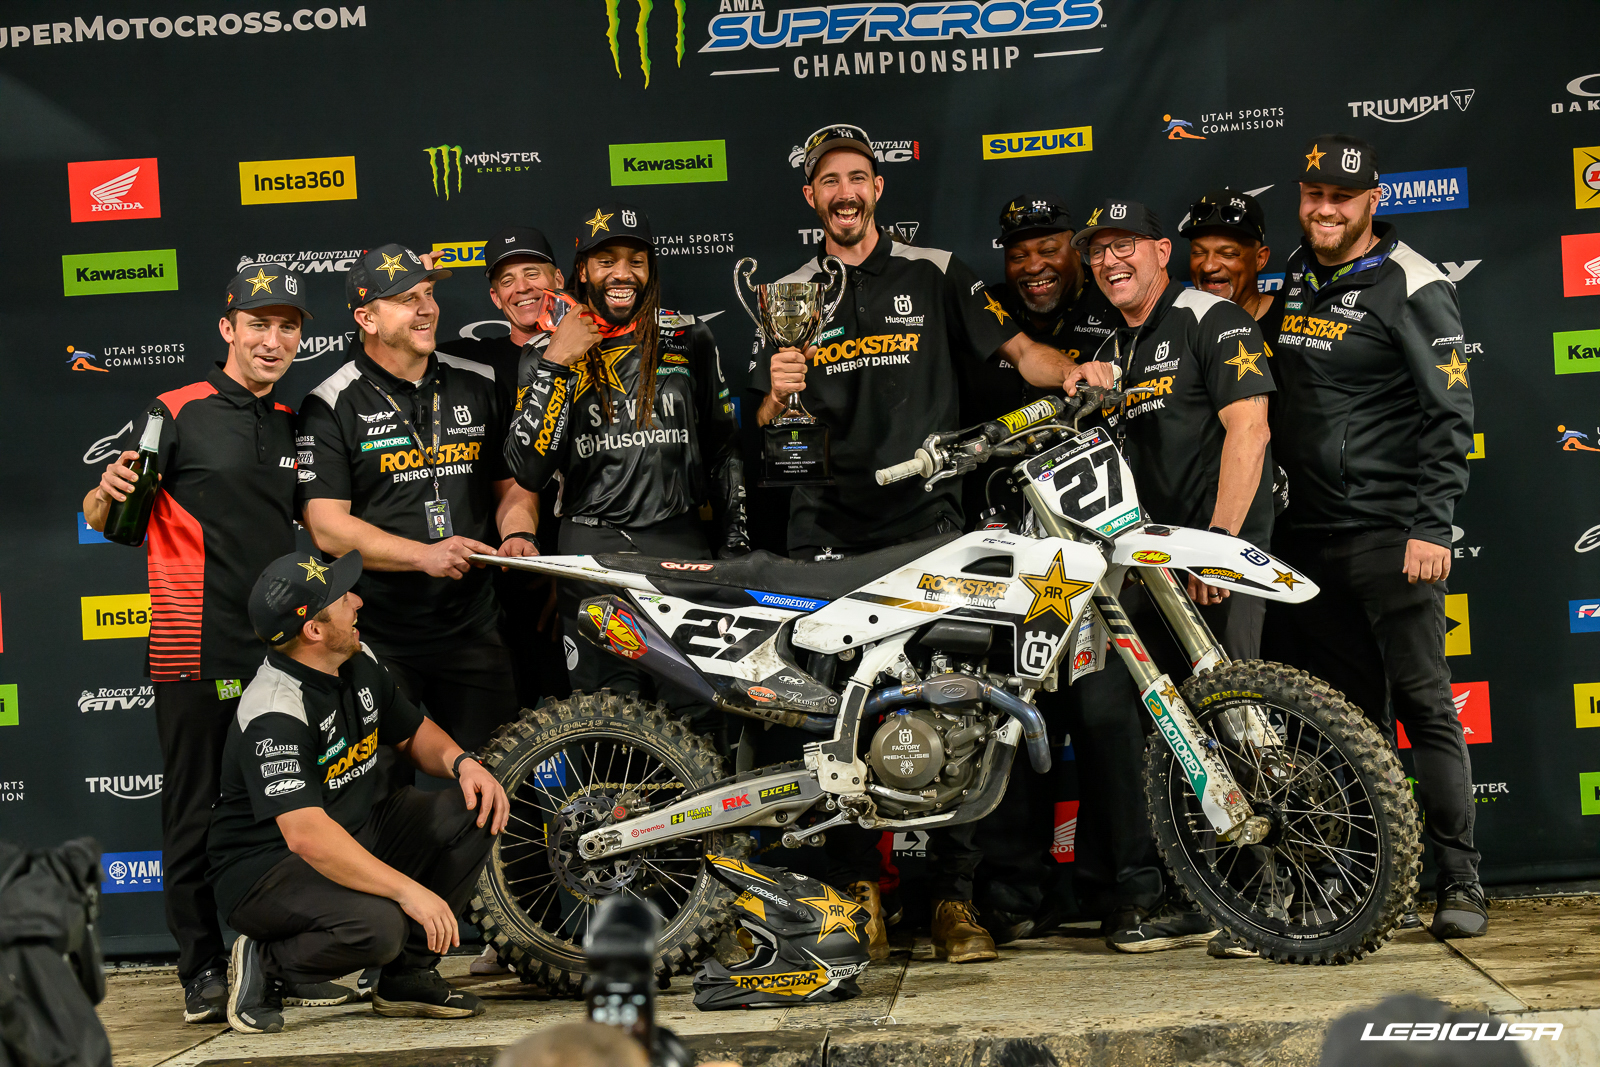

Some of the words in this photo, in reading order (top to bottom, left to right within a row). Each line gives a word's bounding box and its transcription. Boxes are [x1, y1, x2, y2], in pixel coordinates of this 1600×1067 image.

[698, 0, 1104, 53] SUPERCROSS
[793, 46, 1021, 79] CHAMPIONSHIP
[1201, 111, 1233, 123] UTAH
[1238, 107, 1285, 119] SPORTS
[1348, 94, 1449, 120] TRIUMPH
[1202, 118, 1285, 134] COMMISSION
[871, 141, 912, 149] UNTAIN
[989, 132, 1085, 154] SUZUKI
[465, 150, 541, 166] MONSTER
[623, 154, 713, 172] Kawasaki
[477, 165, 531, 173] ENERGY
[253, 169, 345, 192] Insta360
[1392, 177, 1460, 199] YAMAHA
[91, 201, 144, 212] HONDA
[689, 233, 735, 243] SPORTS
[256, 253, 295, 263] ROCKY
[297, 250, 362, 261] MOUNTAIN
[76, 263, 164, 282] Kawasaki
[885, 315, 925, 325] Husqvarna
[104, 345, 135, 356] UTAH
[141, 343, 185, 354] SPORTS
[813, 333, 921, 367] ROCKSTAR
[1305, 337, 1333, 351] DRINK
[105, 355, 185, 368] COMMISSION
[826, 355, 869, 375] ENERGY
[872, 354, 911, 366] DRINK
[534, 376, 567, 456] ROCKSTAR
[373, 436, 410, 449] MOTOREX
[595, 428, 689, 452] Husqvarna
[380, 442, 482, 473] ROCKSTAR
[435, 463, 473, 479] DRINK
[1053, 443, 1124, 523] 27
[1110, 510, 1139, 531] MOTOREX
[661, 561, 715, 571] GUTS
[1201, 568, 1244, 580] ROCKSTAR
[917, 573, 1010, 599] ROCKSTAR
[761, 594, 818, 611] PROGRESSIVE
[96, 607, 152, 627] Insta
[670, 608, 782, 663] 27
[97, 688, 136, 698] ROCKY
[220, 685, 241, 700] RM
[255, 738, 299, 757] PARADISE
[1158, 714, 1205, 781] MOTOREX
[85, 774, 164, 796] TRIUMP
[761, 782, 799, 798] EXCEL
[721, 793, 751, 811] RK
[687, 805, 712, 817] HAAN
[639, 823, 666, 835] brembo
[740, 972, 819, 989] ROCKSTAR
[830, 967, 856, 979] SHOEI
